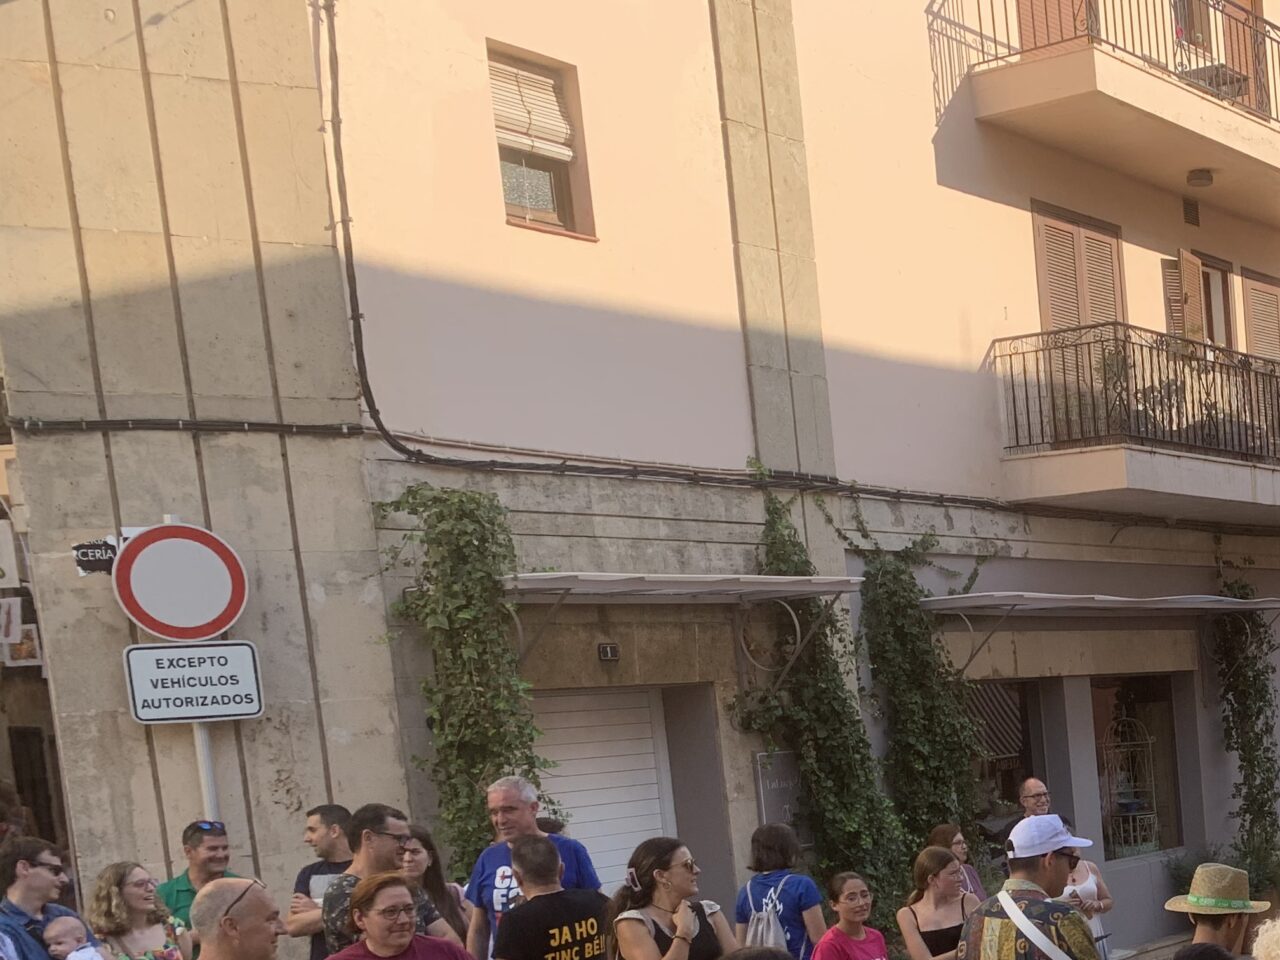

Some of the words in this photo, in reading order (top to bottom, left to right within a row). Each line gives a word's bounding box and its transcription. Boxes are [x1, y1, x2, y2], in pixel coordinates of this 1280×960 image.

[155, 656, 228, 669] EXCEPTO
[150, 674, 240, 689] VEHÍCULOS
[141, 693, 254, 710] AUTORIZADOS
[549, 927, 572, 947] JA
[575, 917, 598, 941] HO
